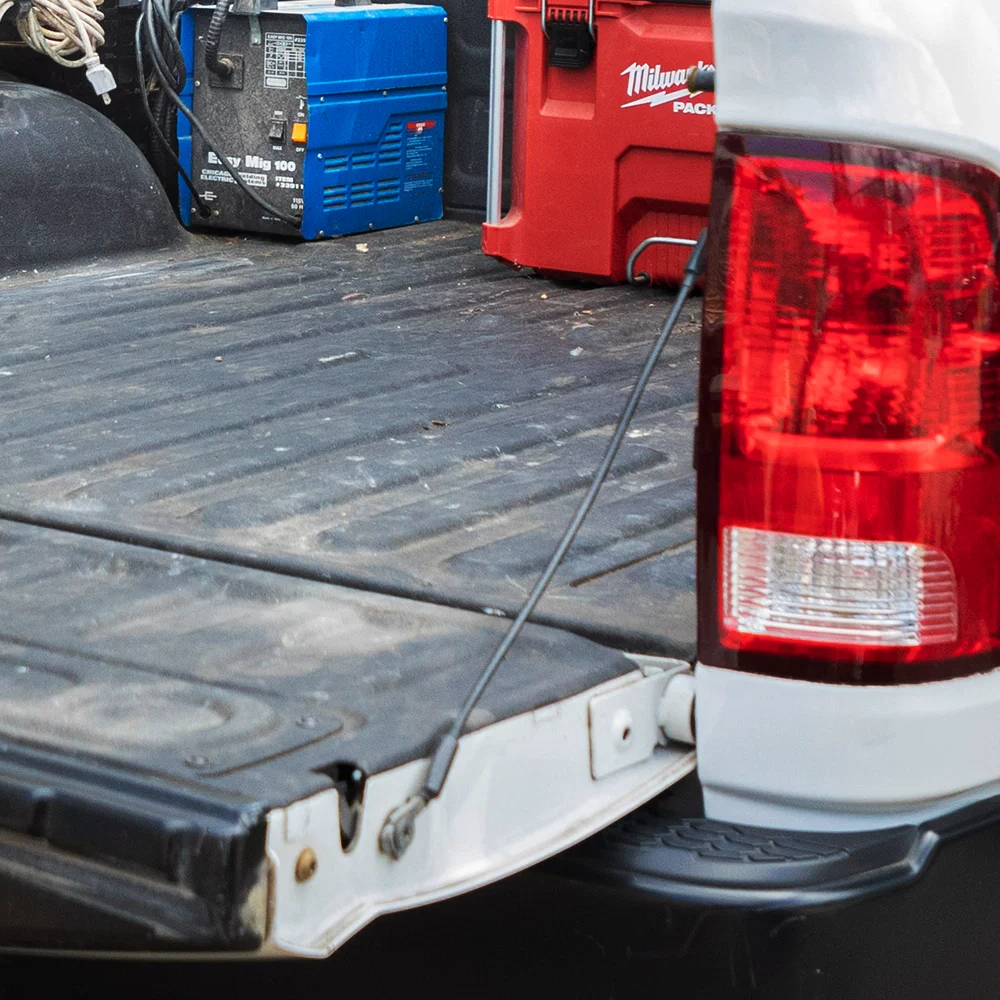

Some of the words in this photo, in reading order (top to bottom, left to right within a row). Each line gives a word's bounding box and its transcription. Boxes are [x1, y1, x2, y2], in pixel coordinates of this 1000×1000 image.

[245, 155, 272, 171] Mig
[274, 160, 296, 172] 100
[241, 173, 266, 181] elding
